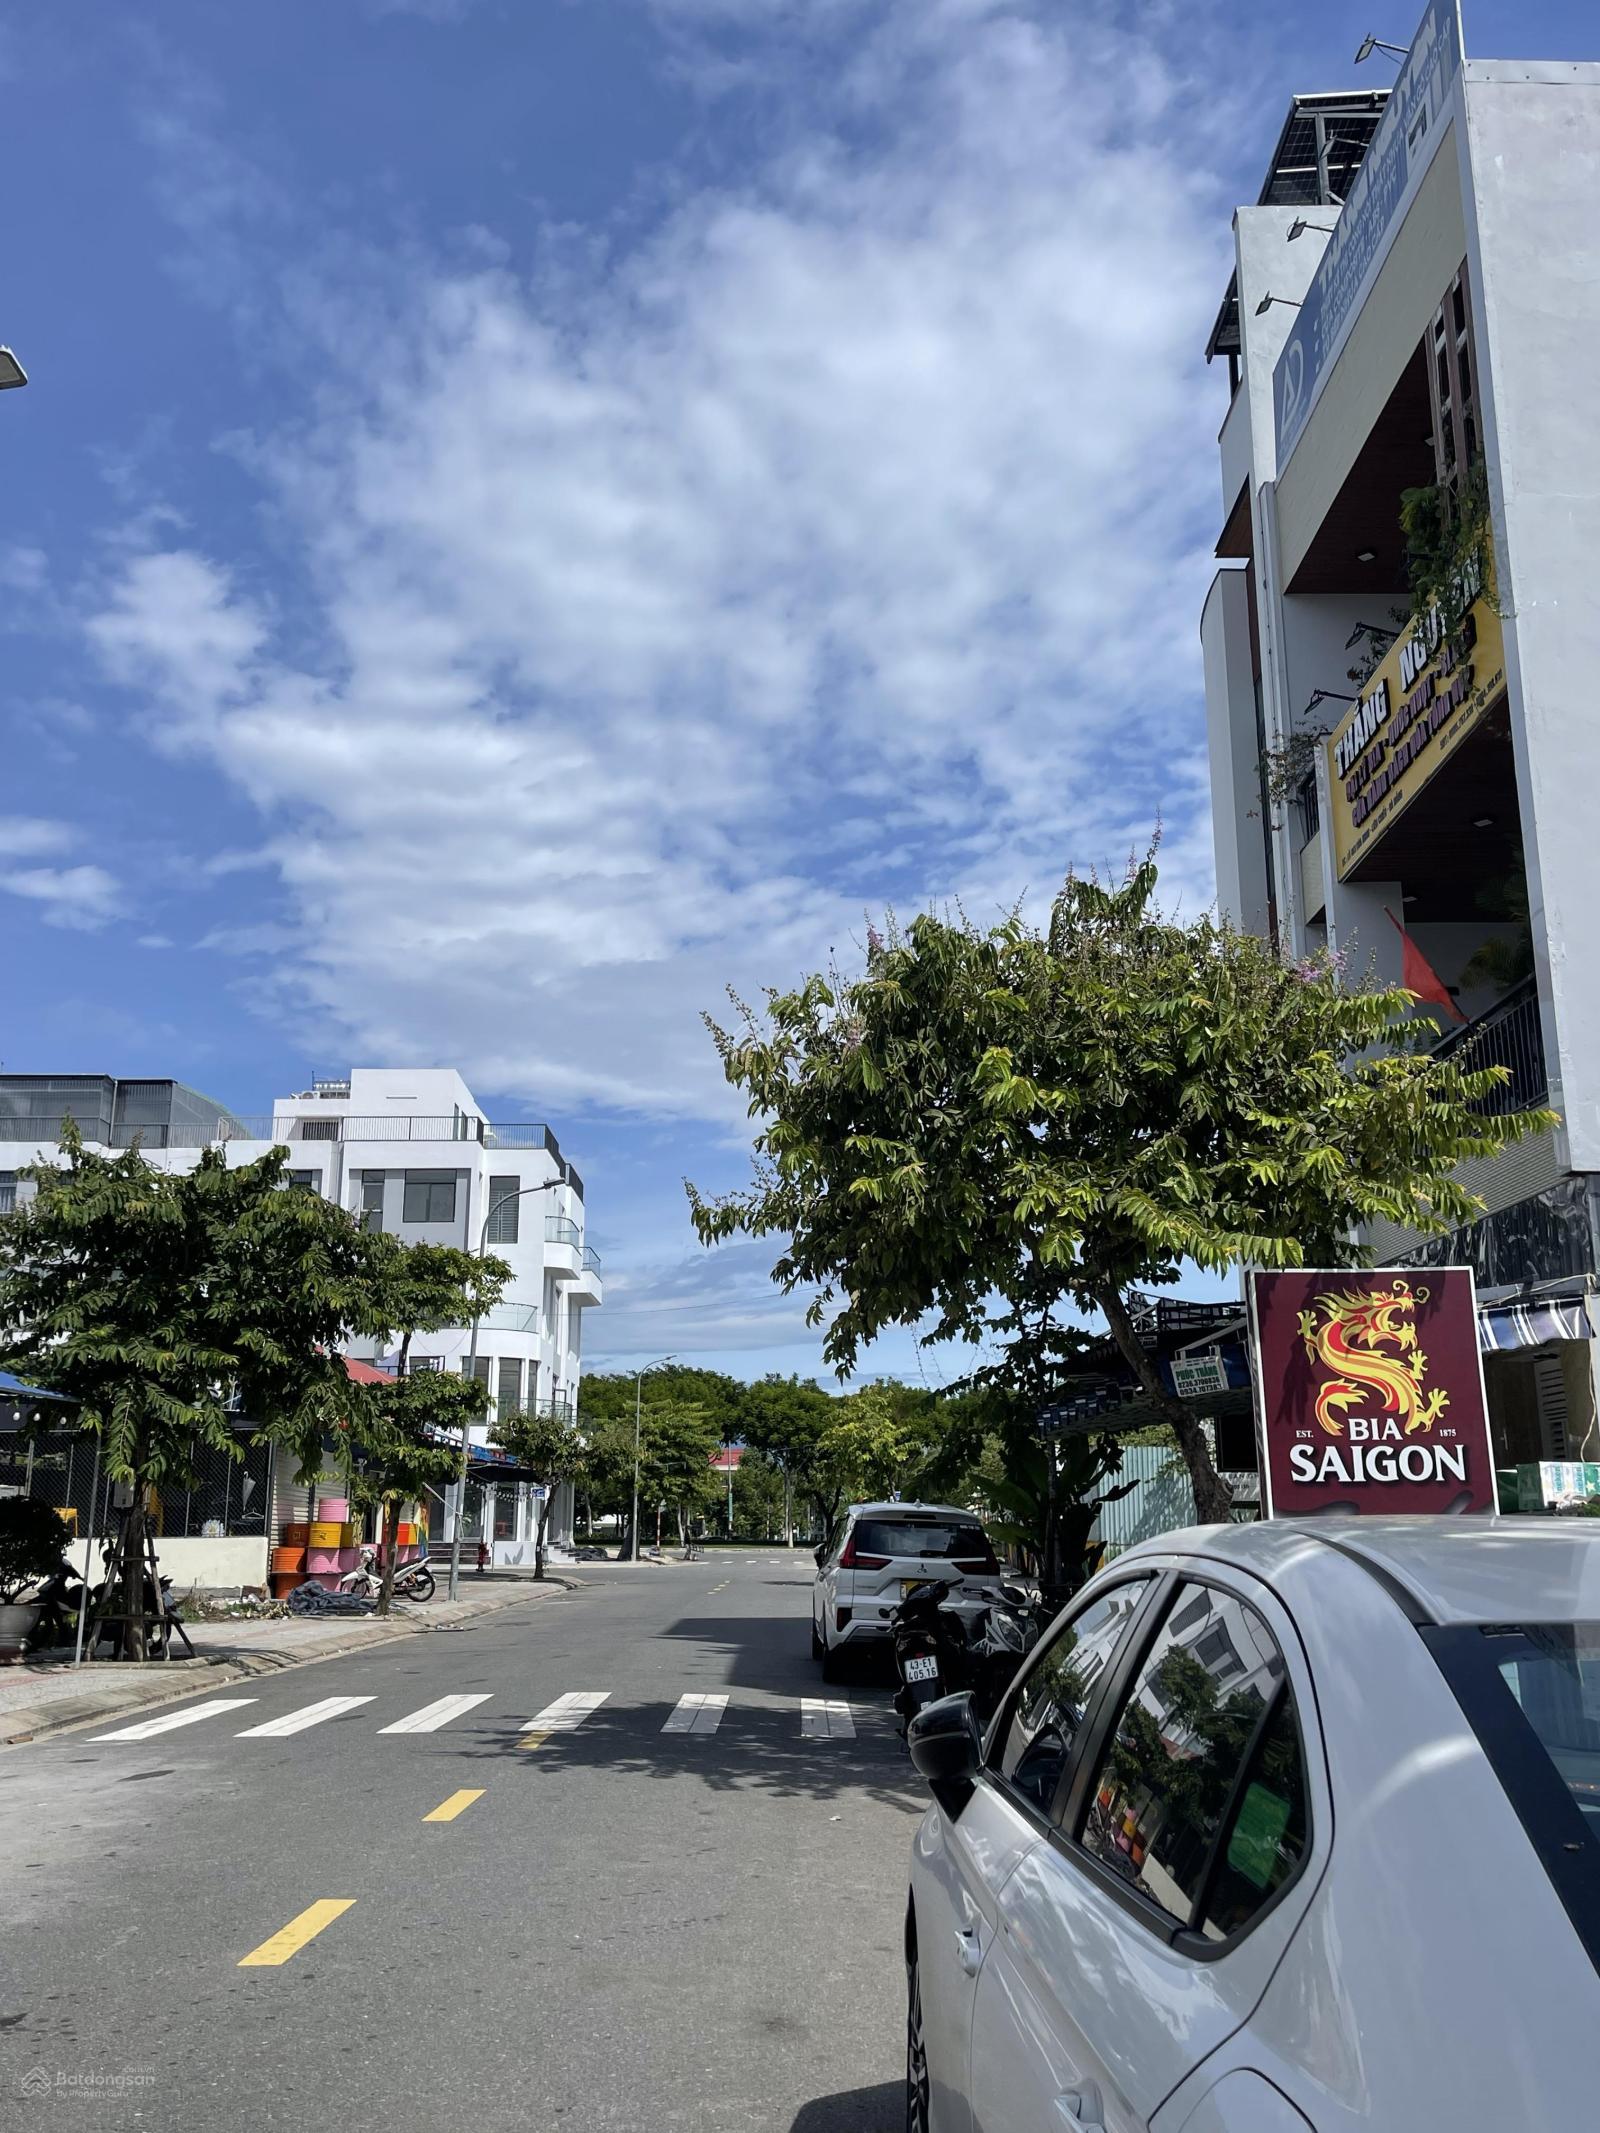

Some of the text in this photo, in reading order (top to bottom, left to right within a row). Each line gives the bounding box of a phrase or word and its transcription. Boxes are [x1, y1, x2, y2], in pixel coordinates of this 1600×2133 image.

[1368, 199, 1379, 237] ABS
[1358, 239, 1371, 281] CAO
[1399, 546, 1480, 692] NGUN
[1296, 1430, 1314, 1438] EST.
[1348, 1418, 1403, 1441] BIA
[1439, 1428, 1457, 1437] 1875
[1290, 1444, 1467, 1482] SAIGON
[908, 1667, 937, 1681] 405.16
